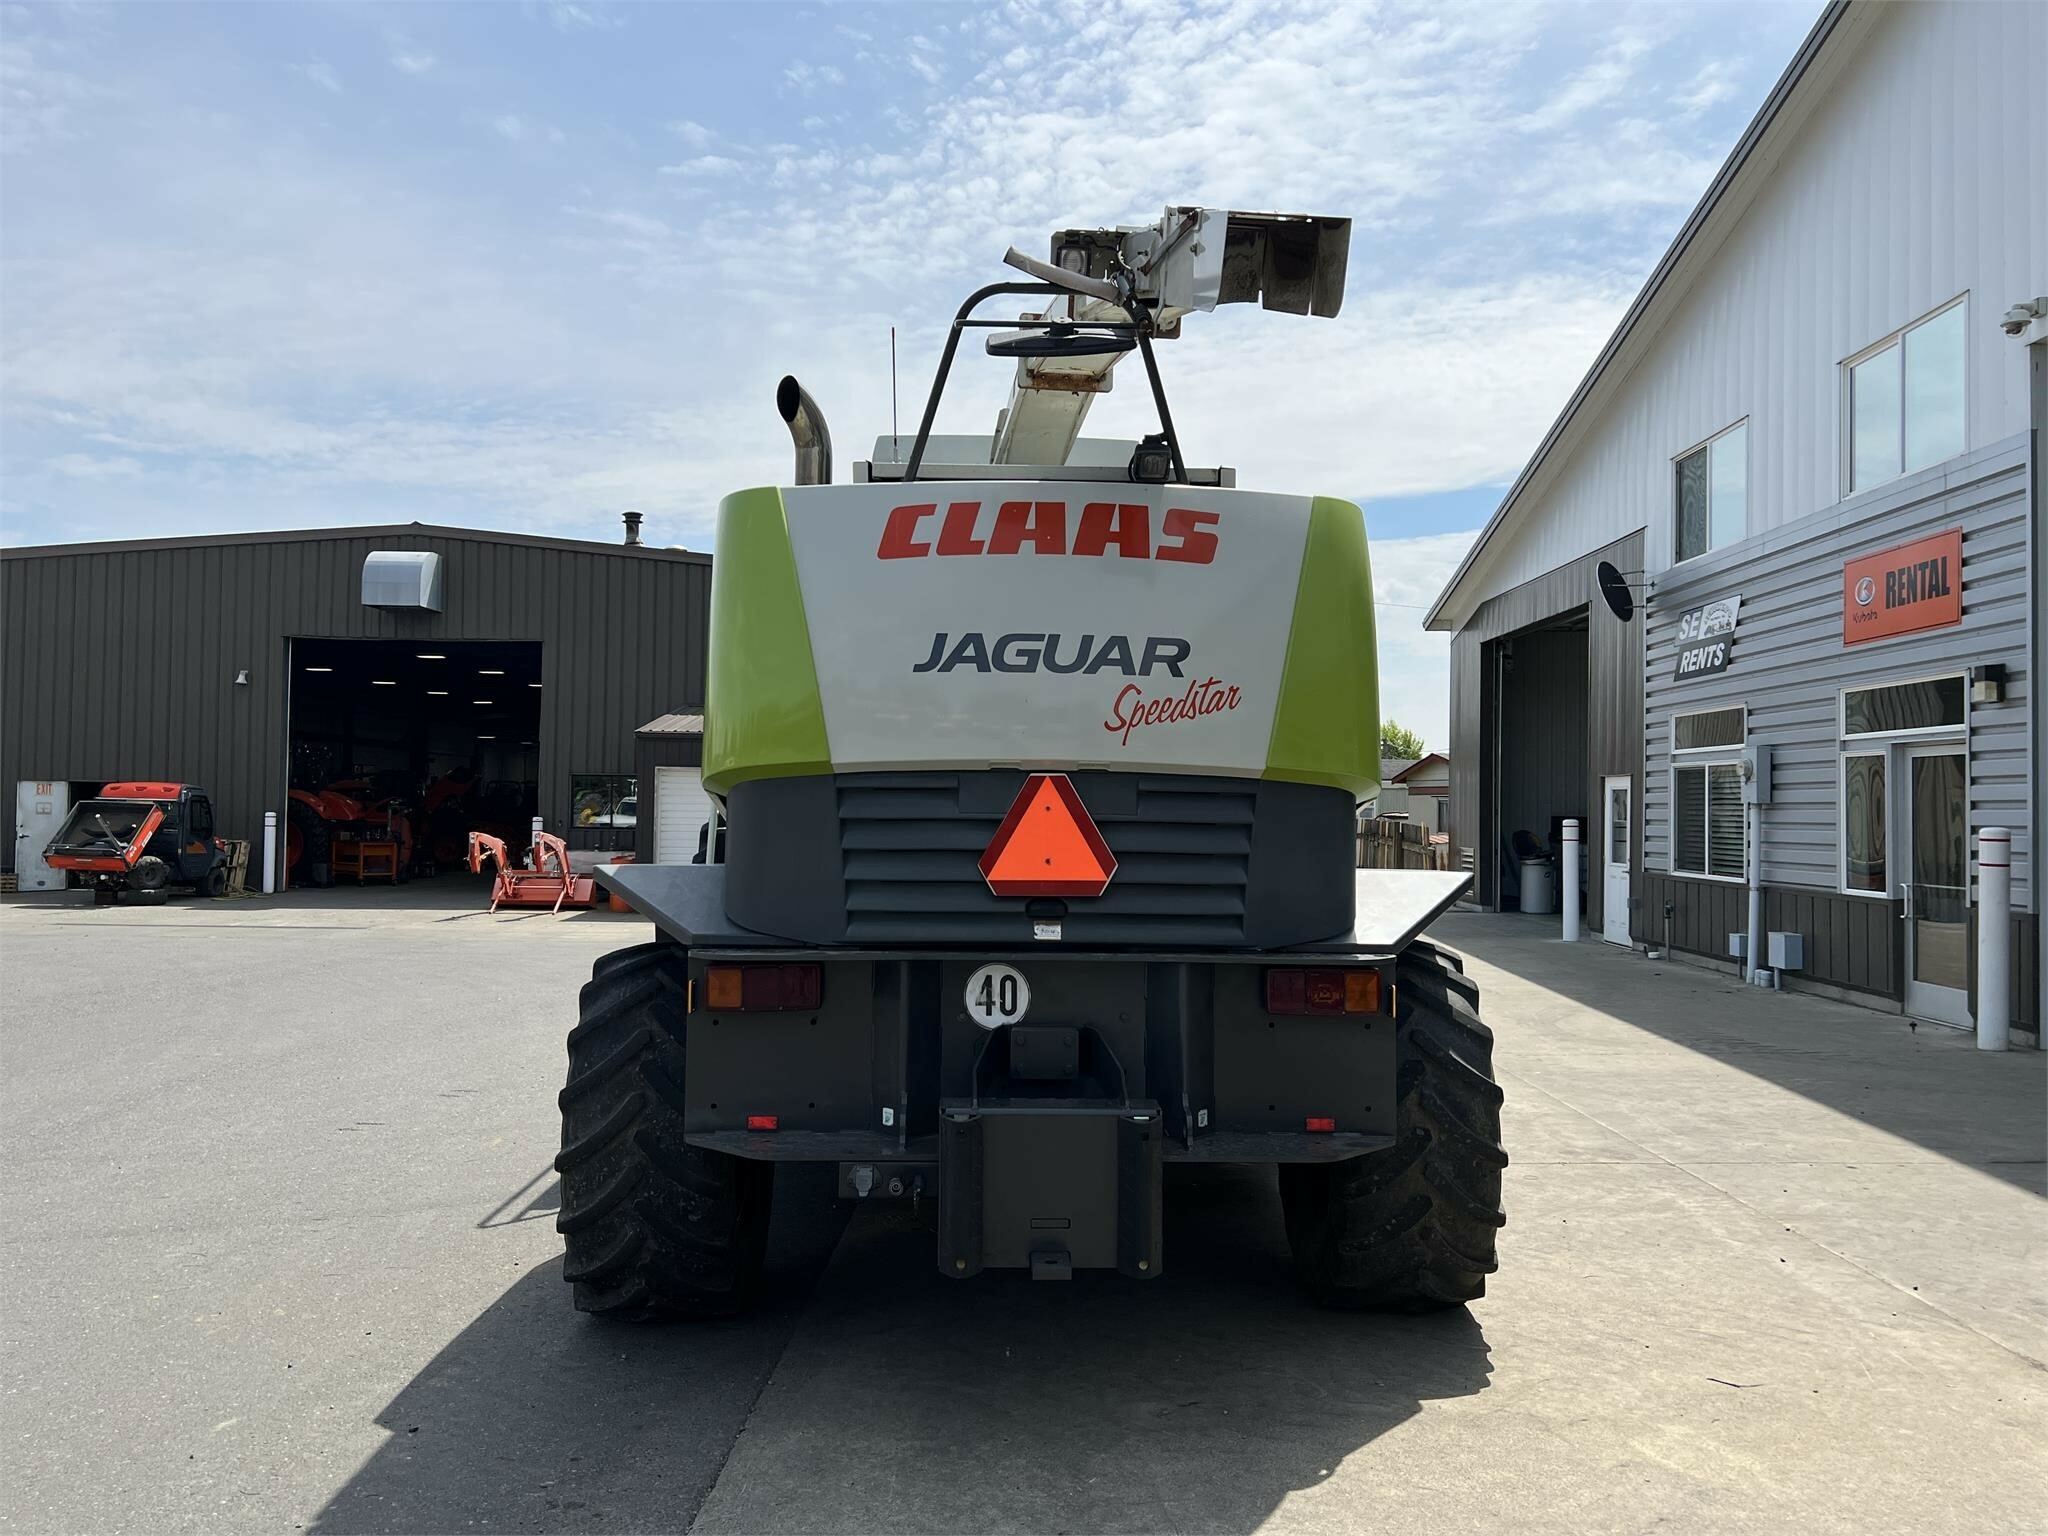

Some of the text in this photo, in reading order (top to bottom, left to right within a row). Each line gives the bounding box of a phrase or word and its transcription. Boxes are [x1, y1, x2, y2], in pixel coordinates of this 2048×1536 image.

[877, 501, 1221, 565] CLAAS
[1885, 556, 1951, 610] RENTAL
[1679, 611, 1702, 641] SE
[912, 632, 1191, 678] JAGUAR
[1679, 642, 1725, 674] RENTS
[1104, 676, 1242, 747] Speedstar
[36, 783, 53, 796] EXIT
[975, 974, 1018, 1017] 40
